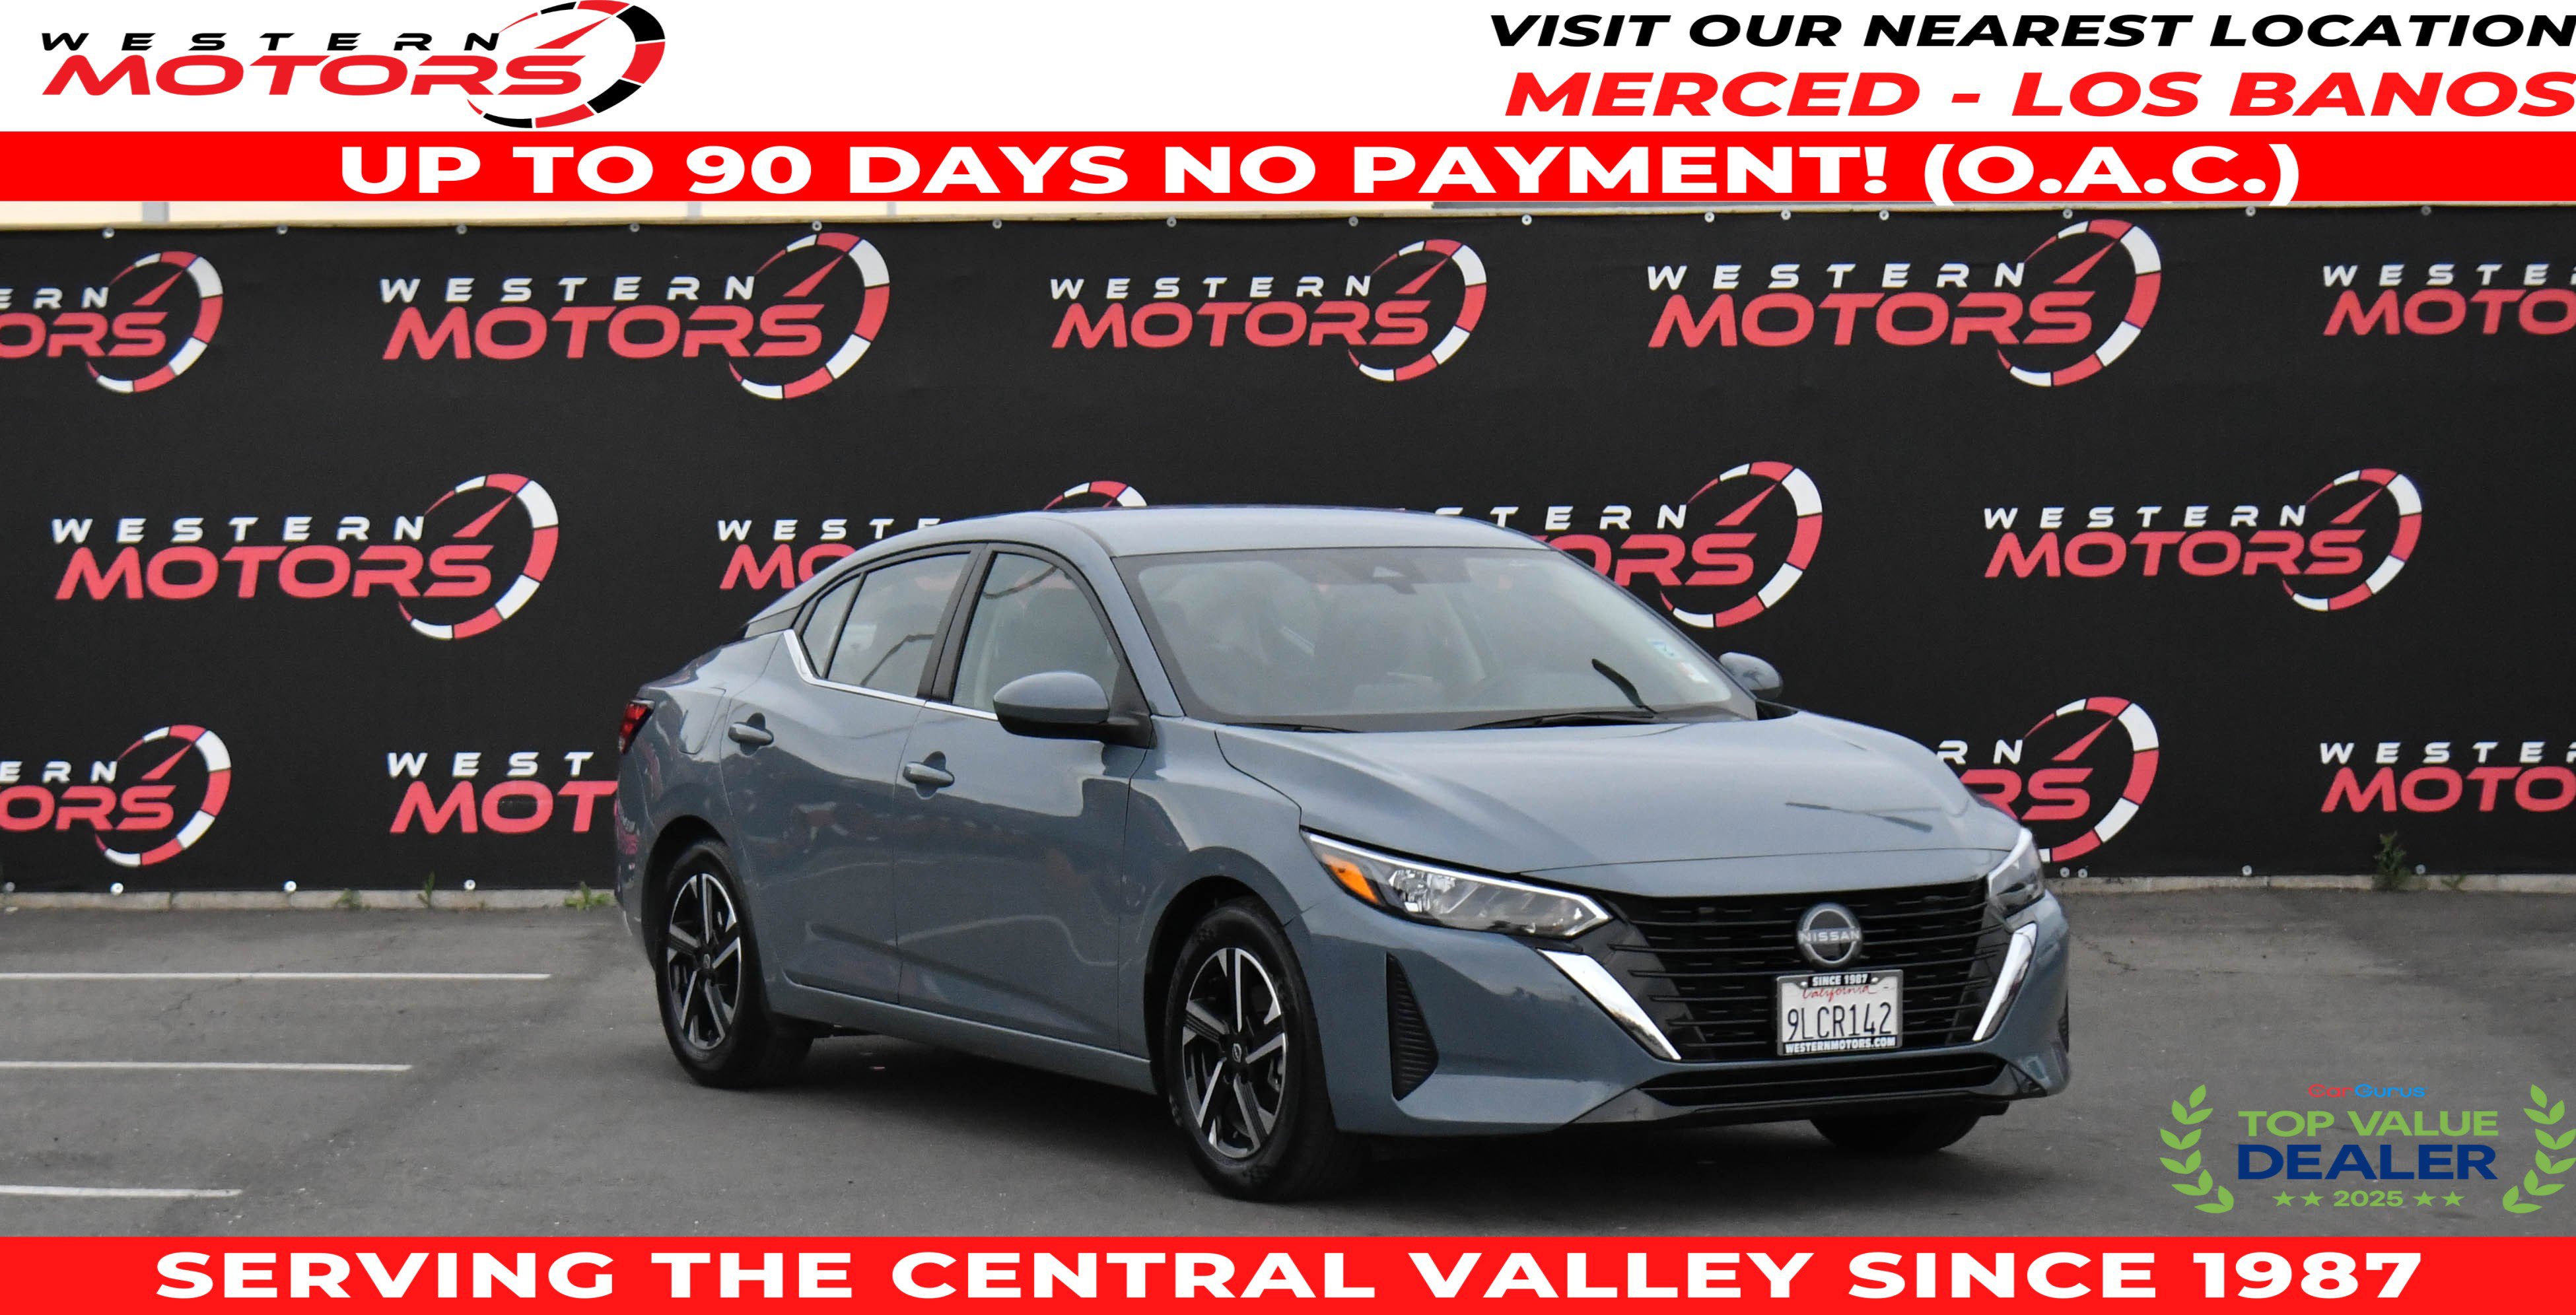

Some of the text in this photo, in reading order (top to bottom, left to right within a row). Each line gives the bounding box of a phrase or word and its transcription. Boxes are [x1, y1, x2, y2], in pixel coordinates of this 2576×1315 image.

[380, 276, 755, 303] WESTERN
[1051, 275, 1371, 300] WESTERN
[1647, 262, 2025, 290] WESTERN
[2323, 264, 2576, 287] WESTE
[382, 304, 825, 360] MOTORS
[1052, 300, 1431, 349] MOTORS
[1648, 290, 2095, 348] MOTORS
[52, 516, 425, 544] WESTERN
[1984, 505, 2306, 529] WESTERN
[1531, 533, 1757, 587] ORS
[1984, 529, 2366, 578] MOTORS
[55, 545, 494, 600] MOTORS
[390, 780, 619, 834] MOT
[1797, 929, 1861, 943] NISSAN
[1812, 974, 1868, 986] SINCE 1987
[1787, 1001, 1893, 1041] 9LCR142
[1785, 1037, 1896, 1053] WESTERNMOTORS.COM
